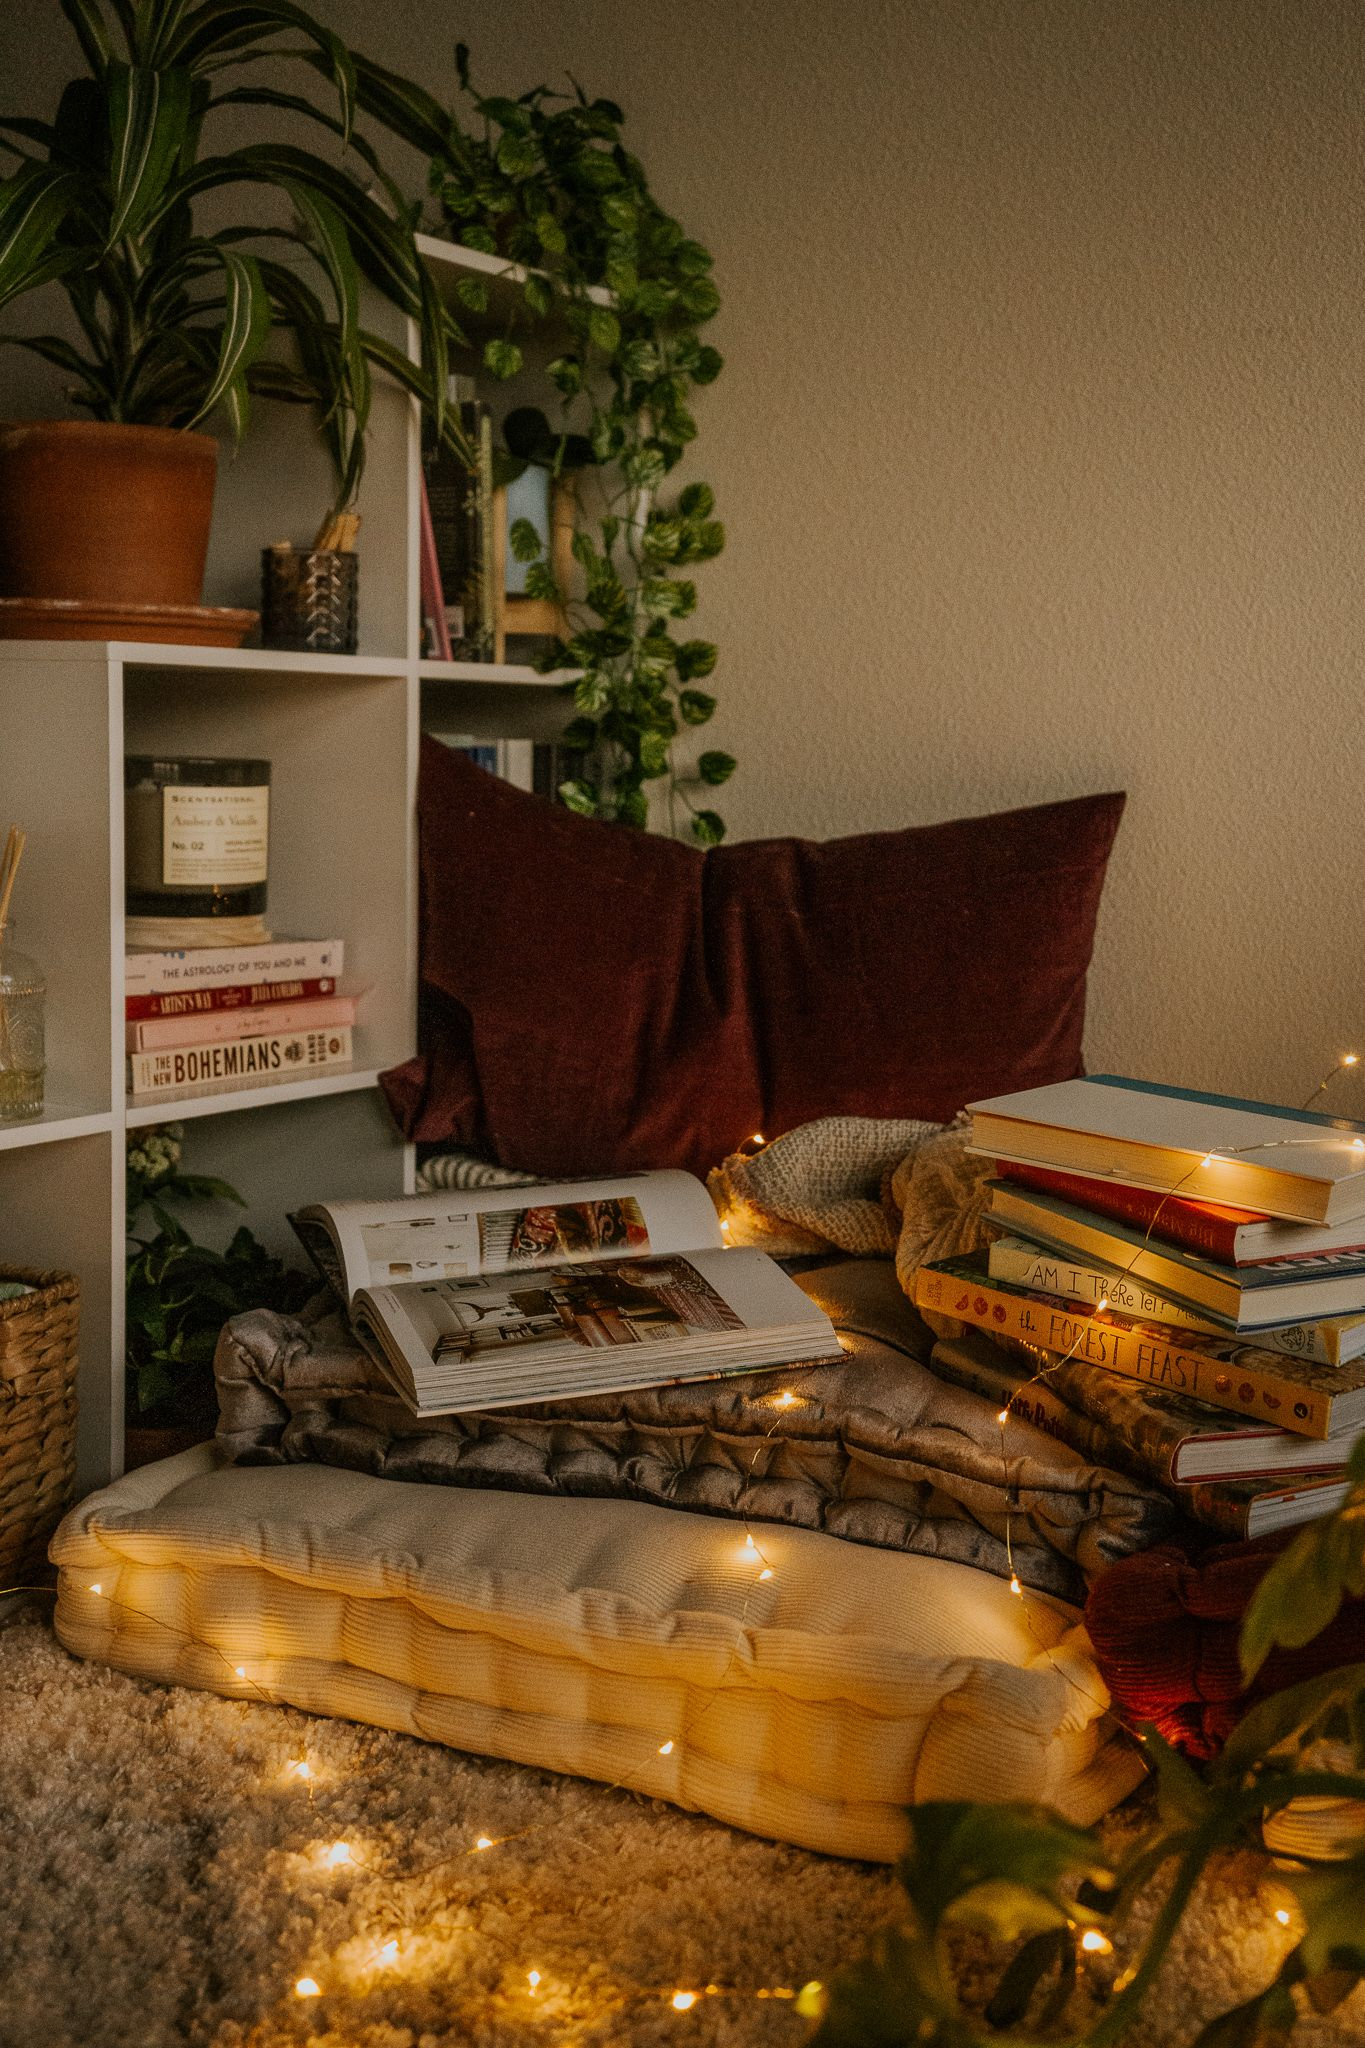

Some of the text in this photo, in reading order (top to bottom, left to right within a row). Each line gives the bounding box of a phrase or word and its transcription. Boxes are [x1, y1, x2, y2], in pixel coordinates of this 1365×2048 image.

[191, 840, 204, 851] 02
[162, 956, 307, 979] THE ASTROLOGY OF YOU AND ME
[155, 1056, 171, 1070] THE
[174, 1040, 281, 1083] BOHEMIANS
[153, 1071, 171, 1086] NEW
[1031, 1264, 1058, 1289] AM
[1067, 1270, 1082, 1295] I
[1018, 1310, 1037, 1332] the
[1048, 1314, 1126, 1367] FOREST
[1136, 1343, 1206, 1391] FEAST
